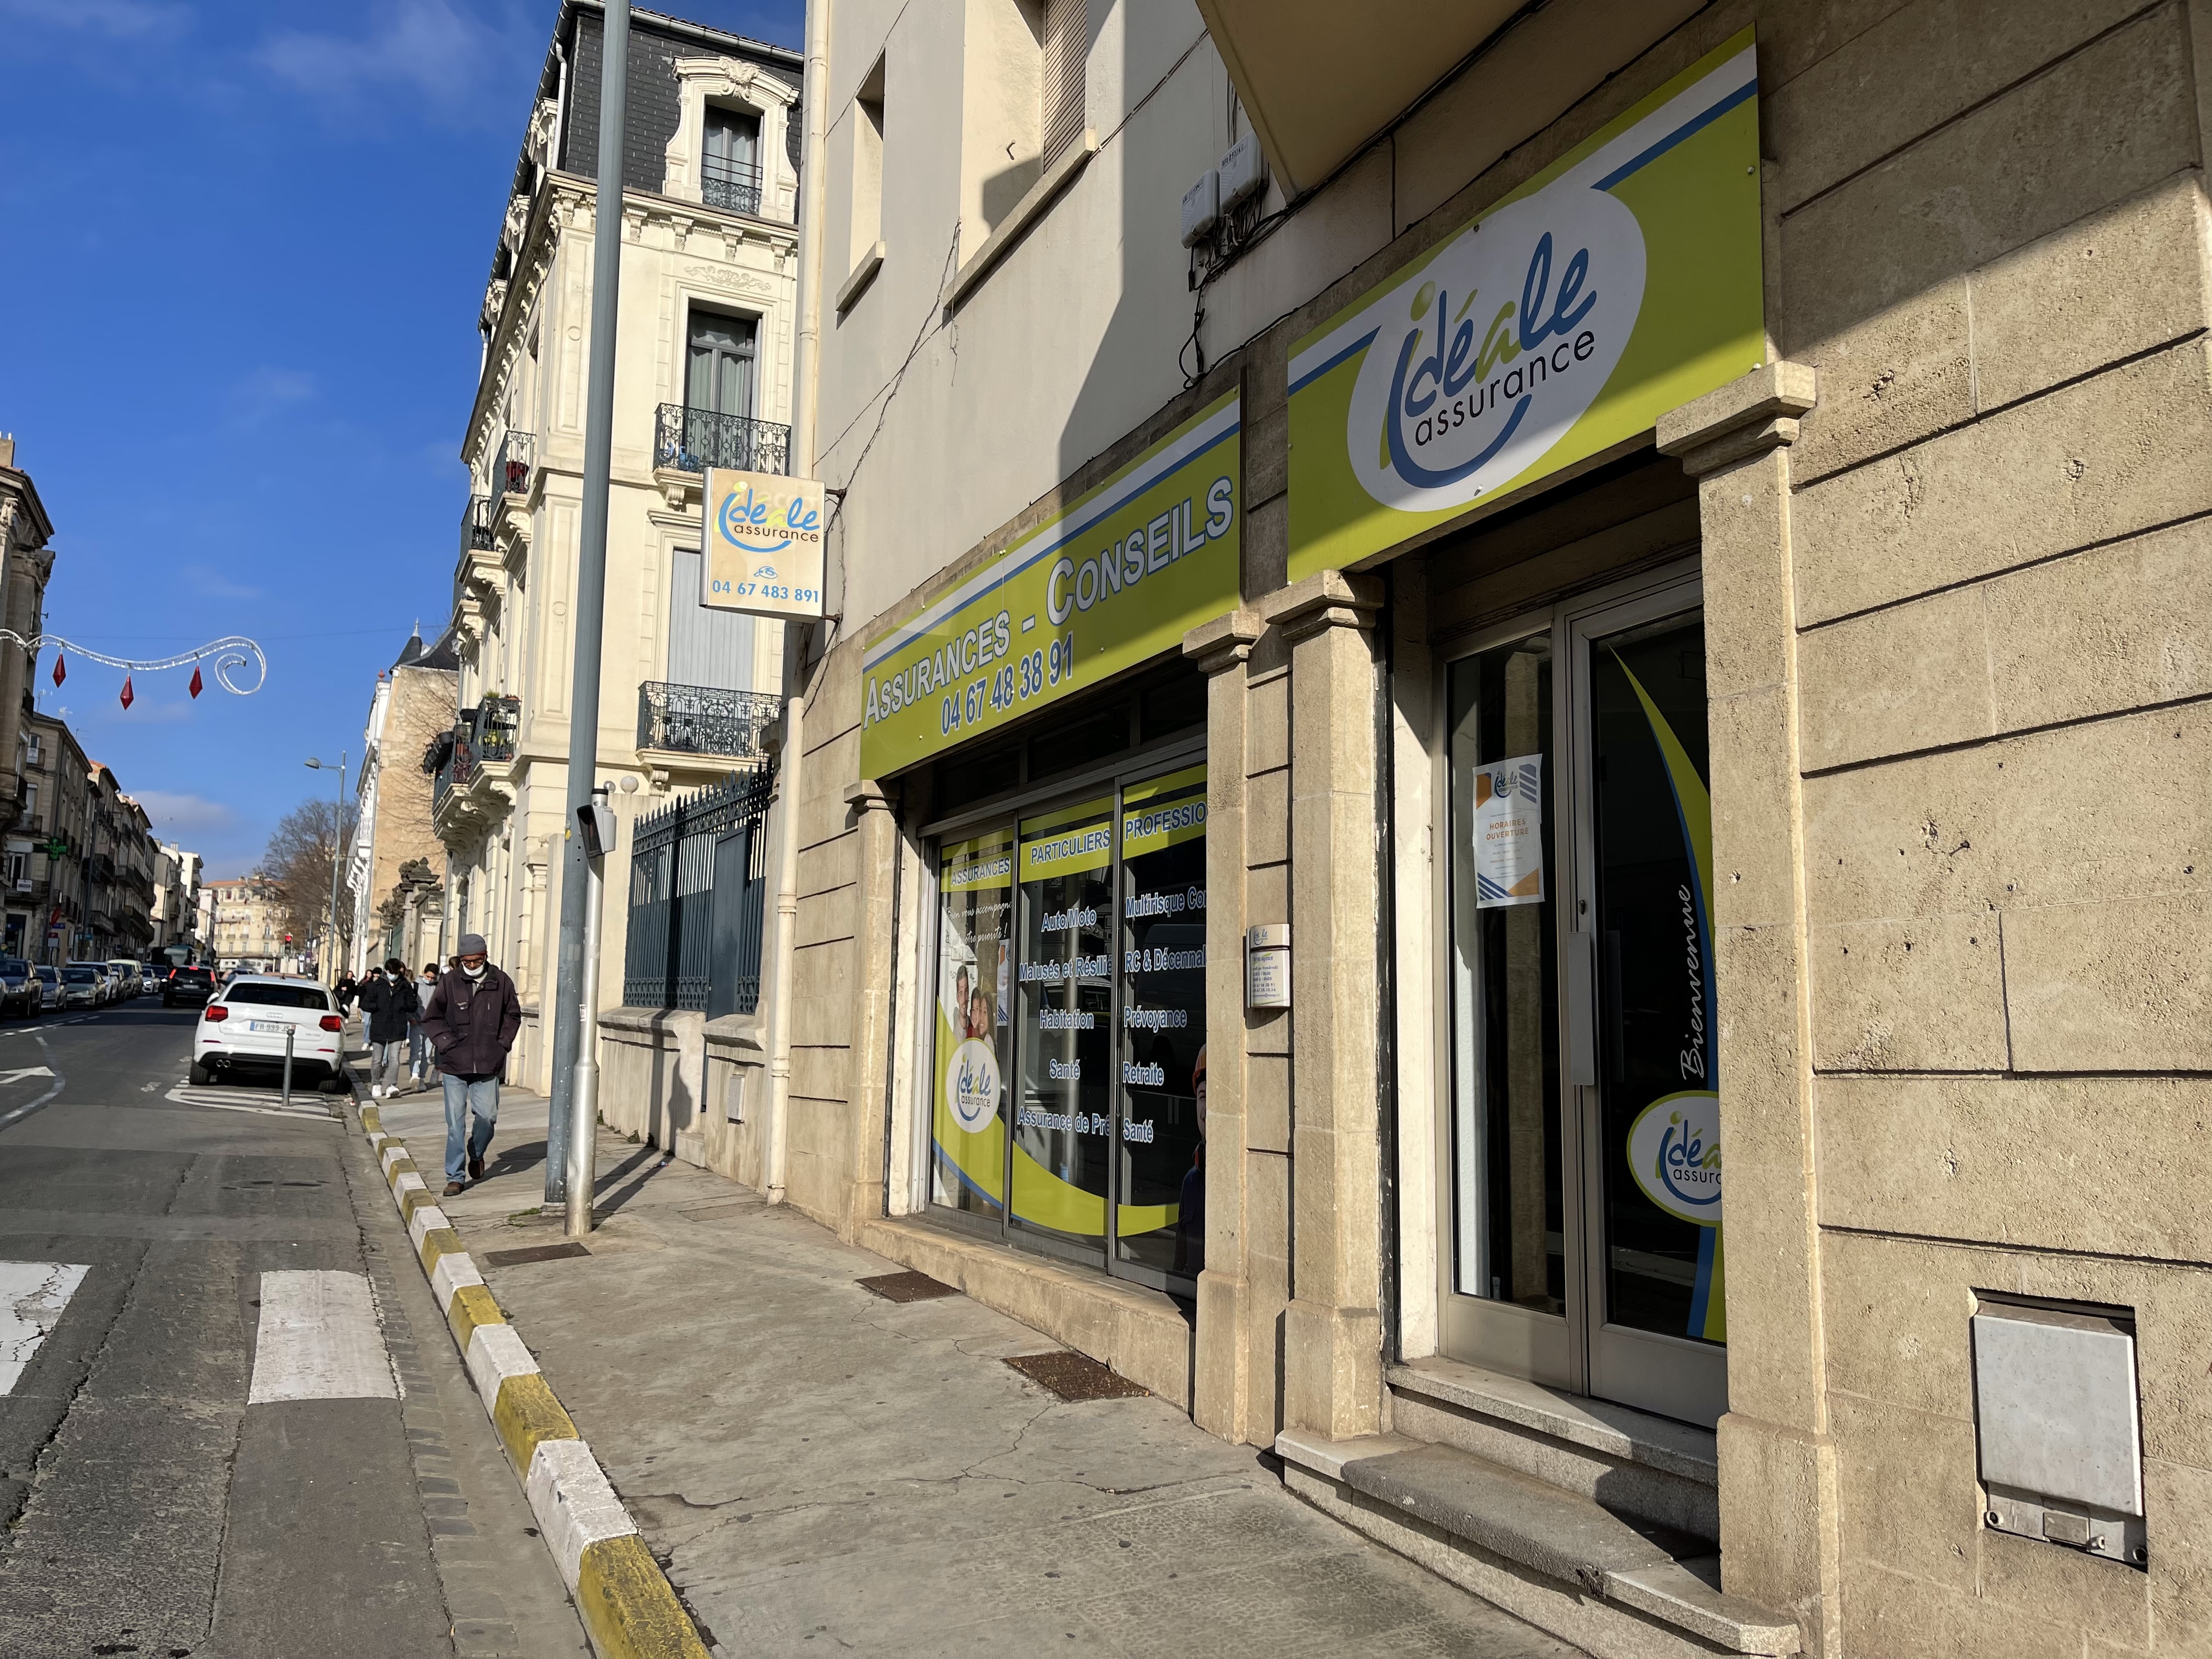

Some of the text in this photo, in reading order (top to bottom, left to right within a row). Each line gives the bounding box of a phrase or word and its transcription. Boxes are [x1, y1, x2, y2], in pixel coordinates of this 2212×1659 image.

[1414, 330, 1595, 447] assurance
[718, 481, 820, 531] idéale
[734, 524, 819, 543] assurance
[713, 580, 819, 603] 04 67 483 891
[862, 609, 1011, 731] ASSURANCES
[1047, 475, 1233, 627] CONSEILS
[940, 631, 1074, 737] 04 67 48 38 91
[1125, 801, 1207, 841] PROFESSIO
[1486, 827, 1529, 840] OUVERTURE
[1489, 818, 1526, 830] HORAIRES
[1031, 828, 1111, 865] PARTICULIERS
[951, 857, 1011, 887] ASSURANCES
[946, 906, 960, 919] Bien
[962, 908, 974, 918] vous
[1126, 892, 1185, 918] Multirisque
[1041, 906, 1097, 932] Auto/Moto
[1019, 959, 1060, 981] Malusés
[1062, 958, 1074, 978] et
[1125, 950, 1141, 973] RC
[1143, 949, 1152, 972] &
[1680, 883, 1705, 1080] Bienvenue
[1040, 1008, 1094, 1030] Habitation
[1124, 1005, 1187, 1034] Prévoyance
[1049, 1058, 1080, 1080] Santé
[1122, 1061, 1164, 1086] Retraite
[961, 1096, 990, 1107] assurance
[1017, 1105, 1073, 1131] Assurance
[1075, 1111, 1089, 1133] de
[1123, 1118, 1154, 1144] Santé
